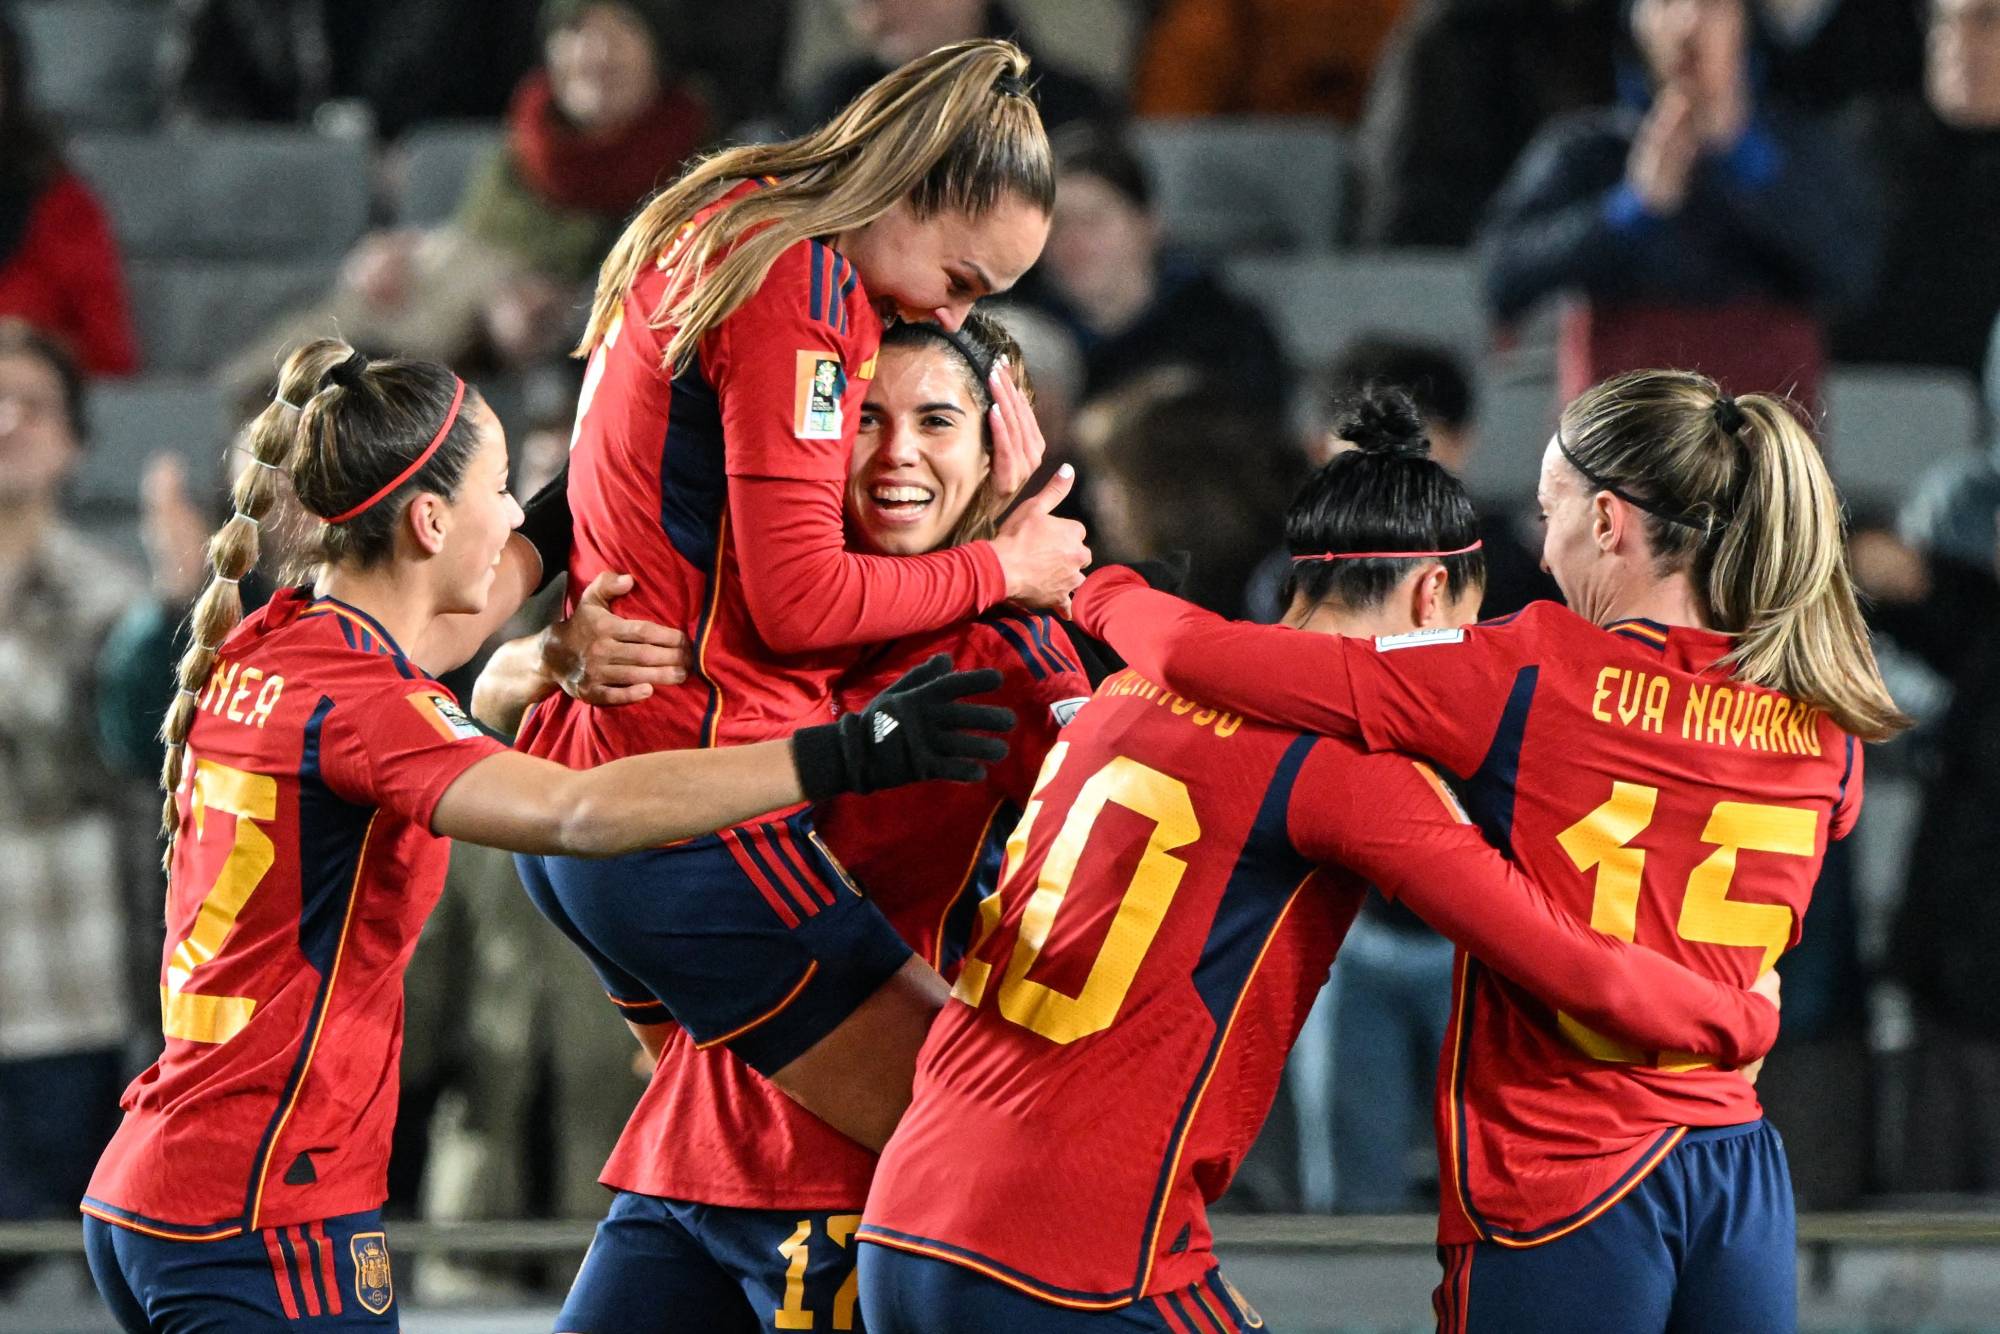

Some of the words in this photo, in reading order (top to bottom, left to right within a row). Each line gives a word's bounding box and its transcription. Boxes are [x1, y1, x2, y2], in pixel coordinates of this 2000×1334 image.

[195, 659, 285, 729] NEA
[1592, 666, 1671, 734] EVA
[160, 743, 278, 1045] 2
[1555, 780, 1819, 1073] 15
[774, 1214, 863, 1331] 17
